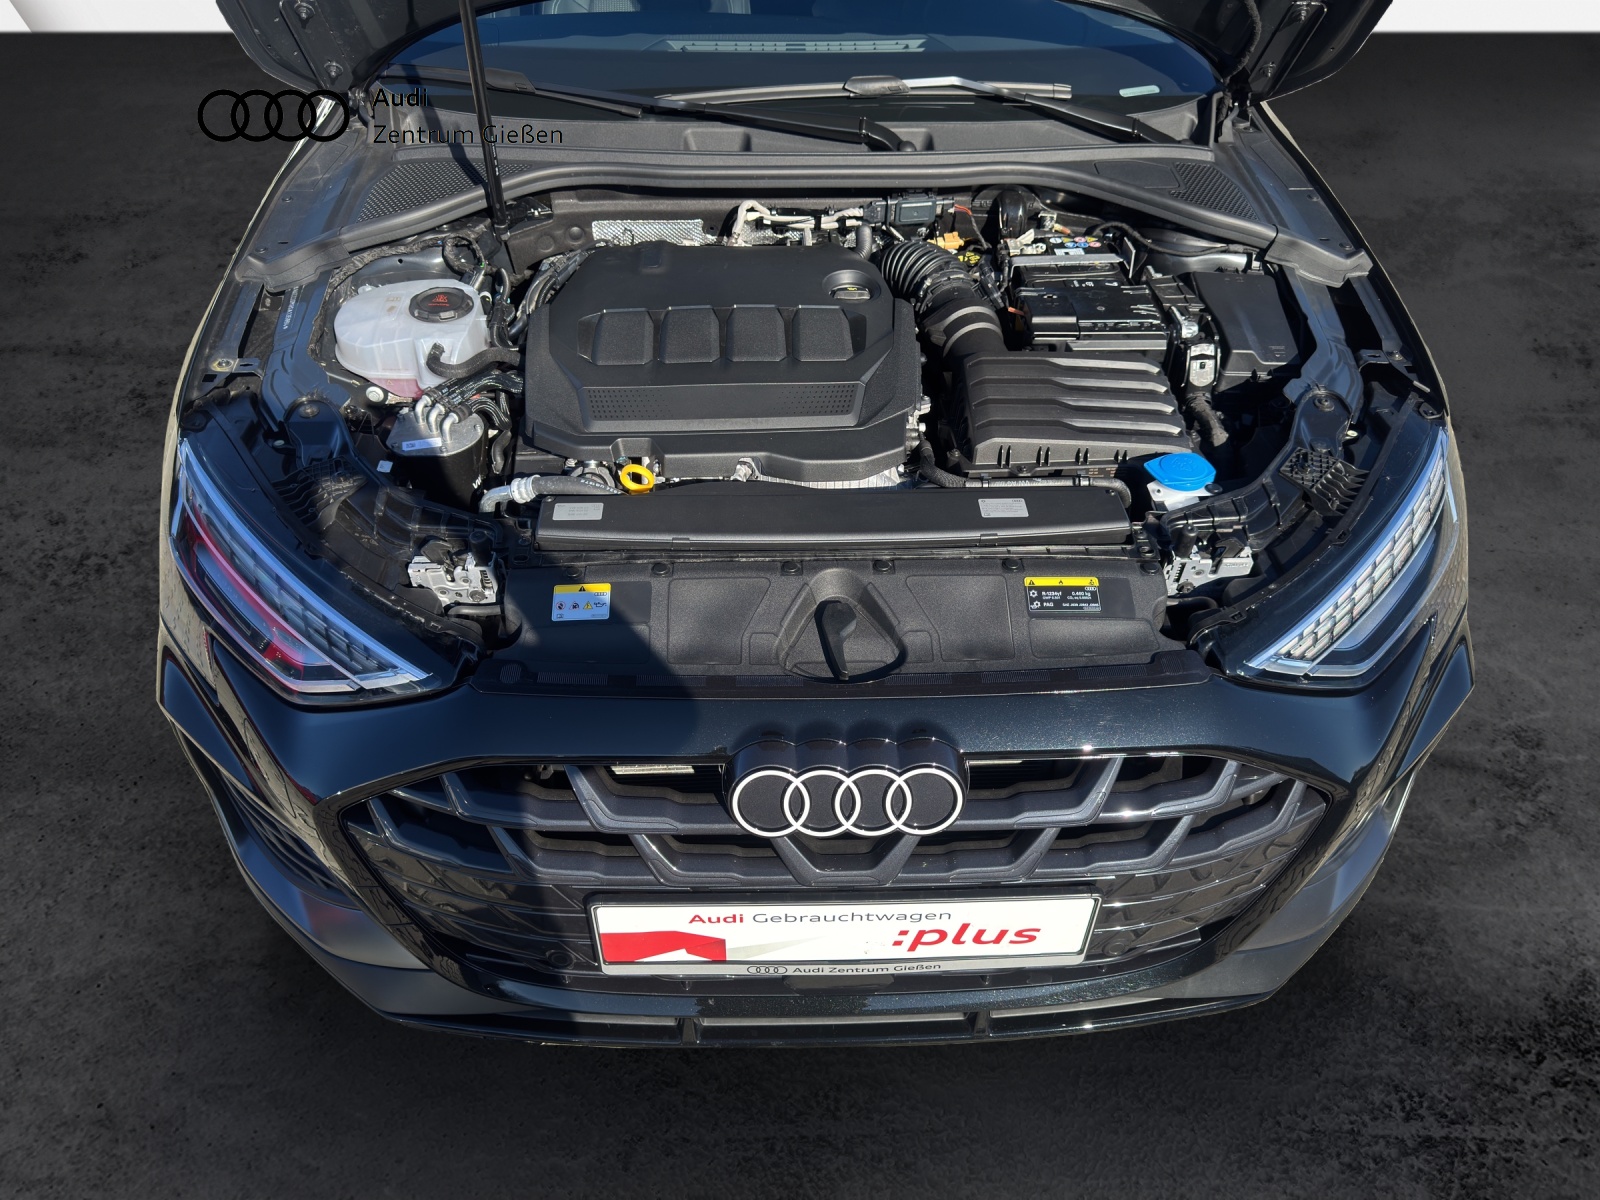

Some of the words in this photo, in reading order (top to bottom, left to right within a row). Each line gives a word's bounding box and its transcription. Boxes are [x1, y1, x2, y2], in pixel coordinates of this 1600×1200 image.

[688, 913, 744, 925] Audi
[752, 911, 952, 924] Gebrauchtwagen
[791, 966, 825, 974] Audi
[828, 965, 889, 974] Zentrum
[893, 963, 942, 972] Gießen
